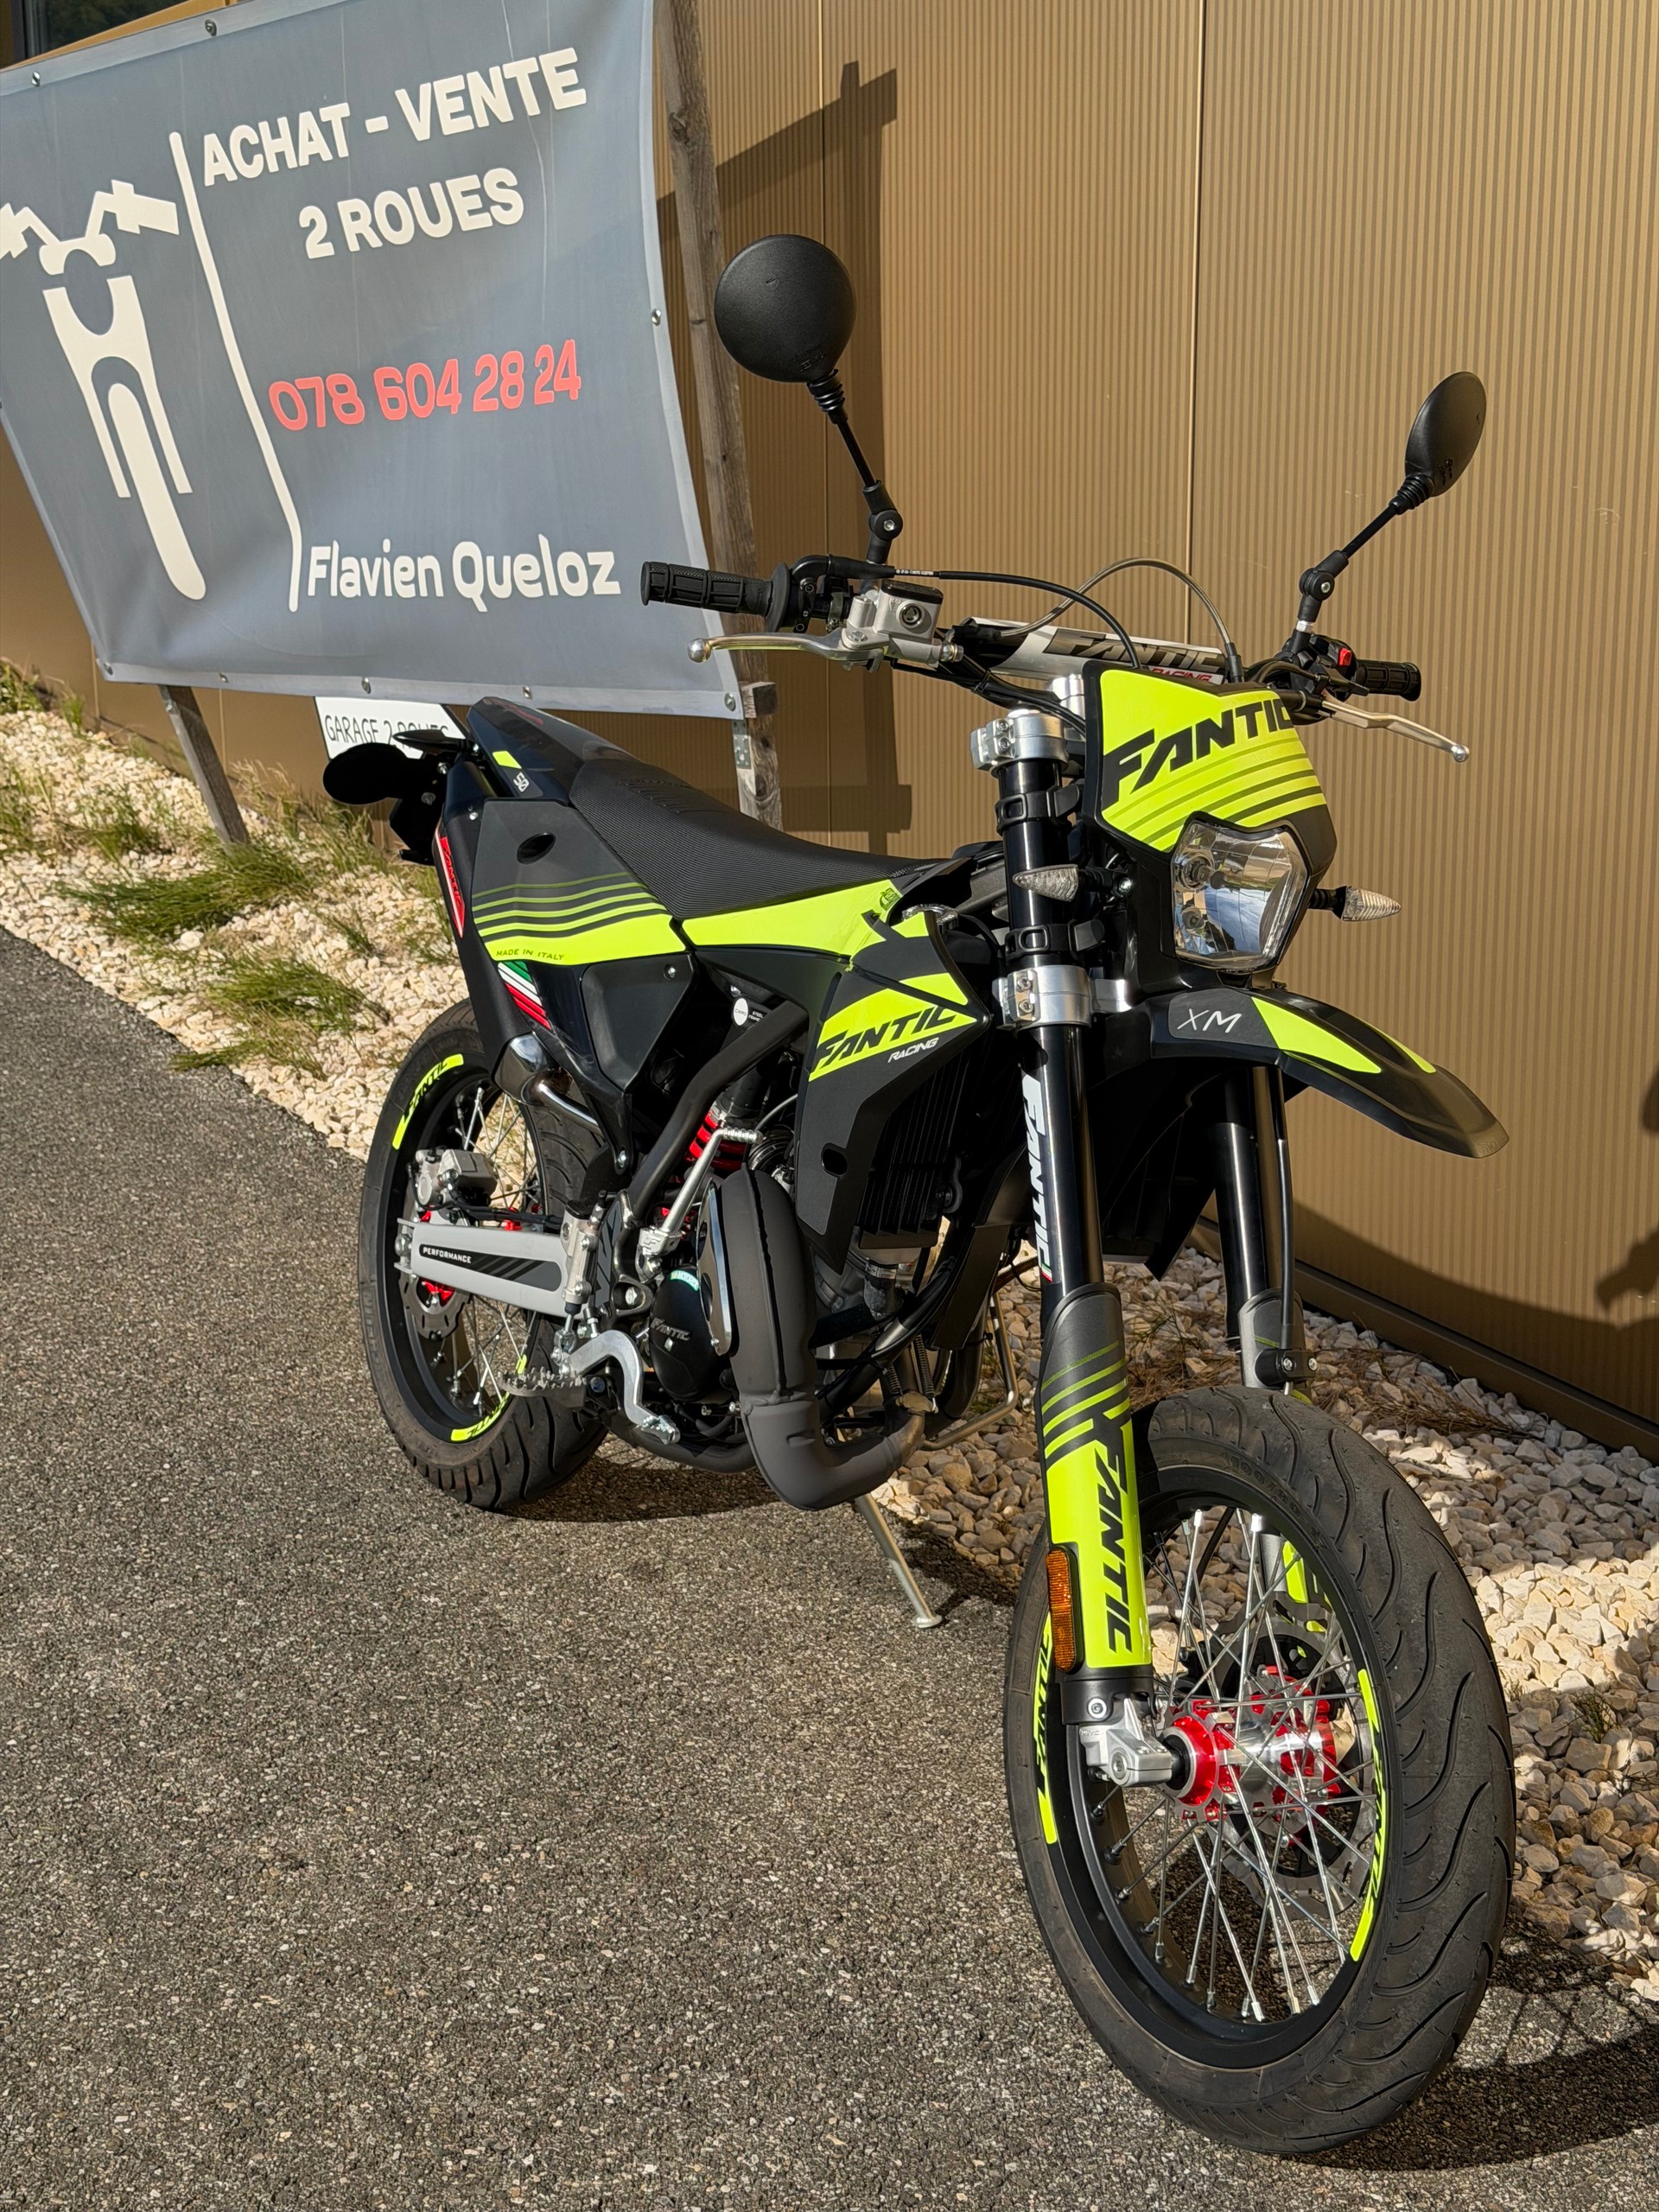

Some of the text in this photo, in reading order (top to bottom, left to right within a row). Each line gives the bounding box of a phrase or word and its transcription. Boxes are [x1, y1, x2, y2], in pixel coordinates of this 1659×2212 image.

[203, 48, 588, 187] ACHAT - VENTE
[299, 168, 524, 260] 2 ROUES
[268, 339, 582, 432] 078 604 28 24
[308, 534, 620, 613] Flavien Queloz
[1043, 628, 1221, 672] FANTIC
[324, 714, 378, 744] GARAGE
[383, 719, 393, 745] 2
[1102, 697, 1297, 810] FANTIC
[512, 771, 529, 792] 50
[537, 951, 565, 961] ITALY
[810, 1005, 957, 1073] FANTIC
[1177, 1008, 1242, 1034] XM
[887, 1036, 940, 1064] RACING
[1021, 1073, 1052, 1268] FANTIC
[423, 1246, 472, 1264] PERFORMANCE
[650, 1317, 690, 1341] FANTIC
[1092, 1417, 1133, 1654] FANTIC
